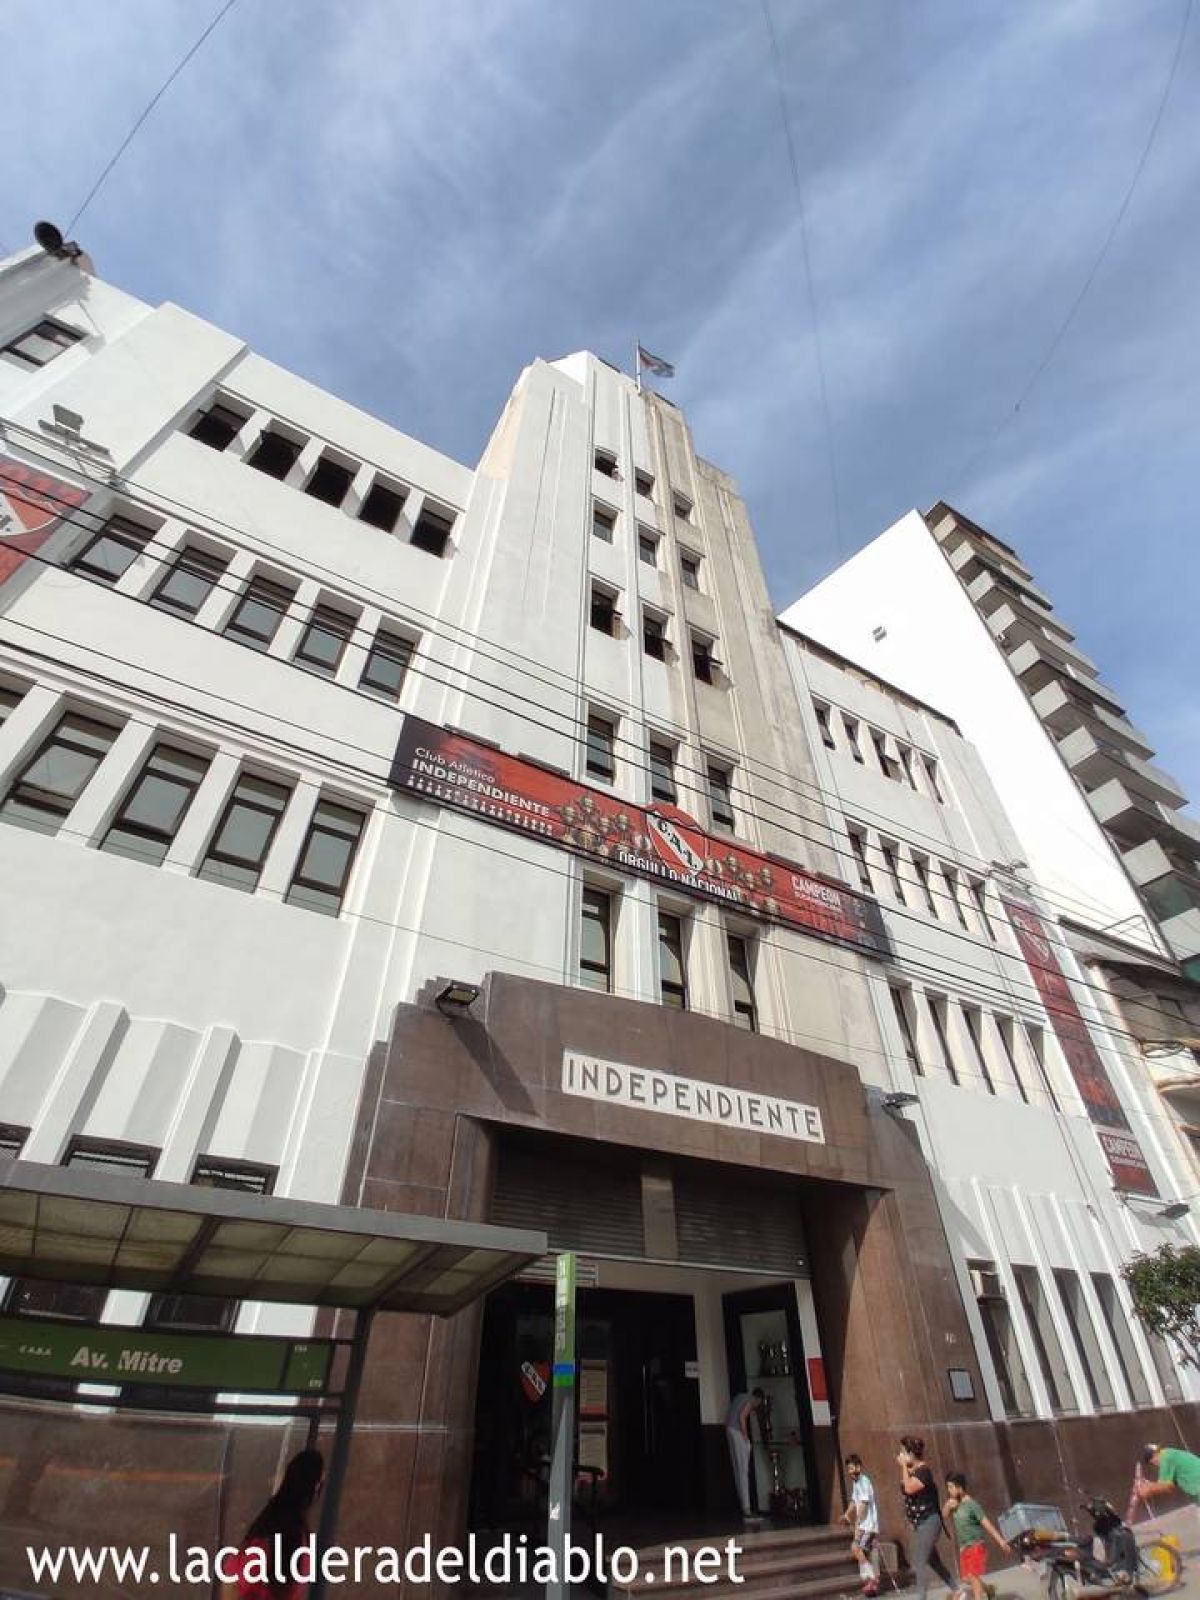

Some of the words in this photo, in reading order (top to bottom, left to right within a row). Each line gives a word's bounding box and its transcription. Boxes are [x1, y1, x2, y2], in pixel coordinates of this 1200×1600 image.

[414, 747, 446, 765] Club
[411, 758, 550, 816] INDEPENDIENTE
[567, 1058, 821, 1137] INDEPENDIENTE
[70, 1346, 109, 1369] Av.
[118, 1350, 184, 1374] Mitre
